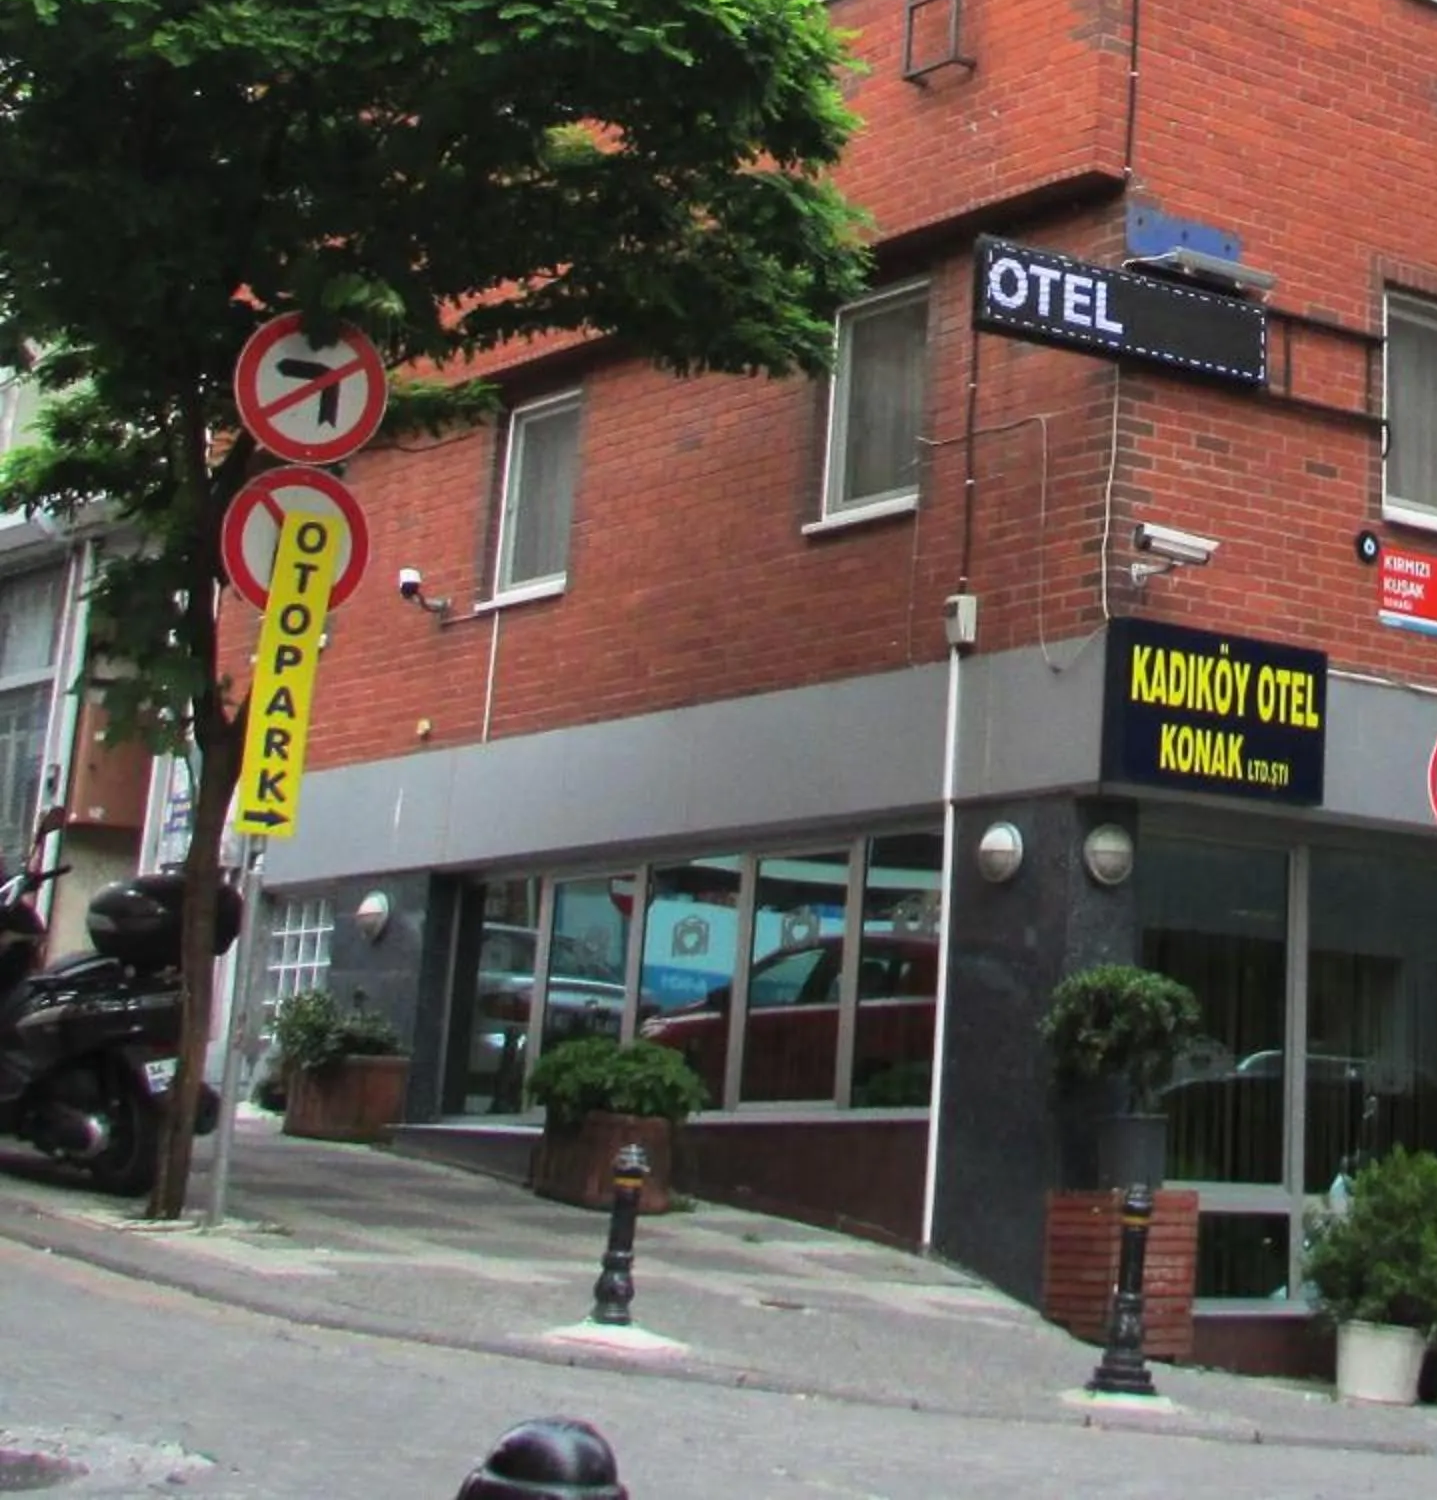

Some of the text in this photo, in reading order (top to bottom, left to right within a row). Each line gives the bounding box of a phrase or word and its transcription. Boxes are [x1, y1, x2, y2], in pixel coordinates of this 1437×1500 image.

[989, 257, 1123, 334] OTEL
[257, 521, 328, 803] OTOPARK
[1131, 643, 1320, 729] KADIKÖY OTEL
[1160, 723, 1244, 780] KONAK
